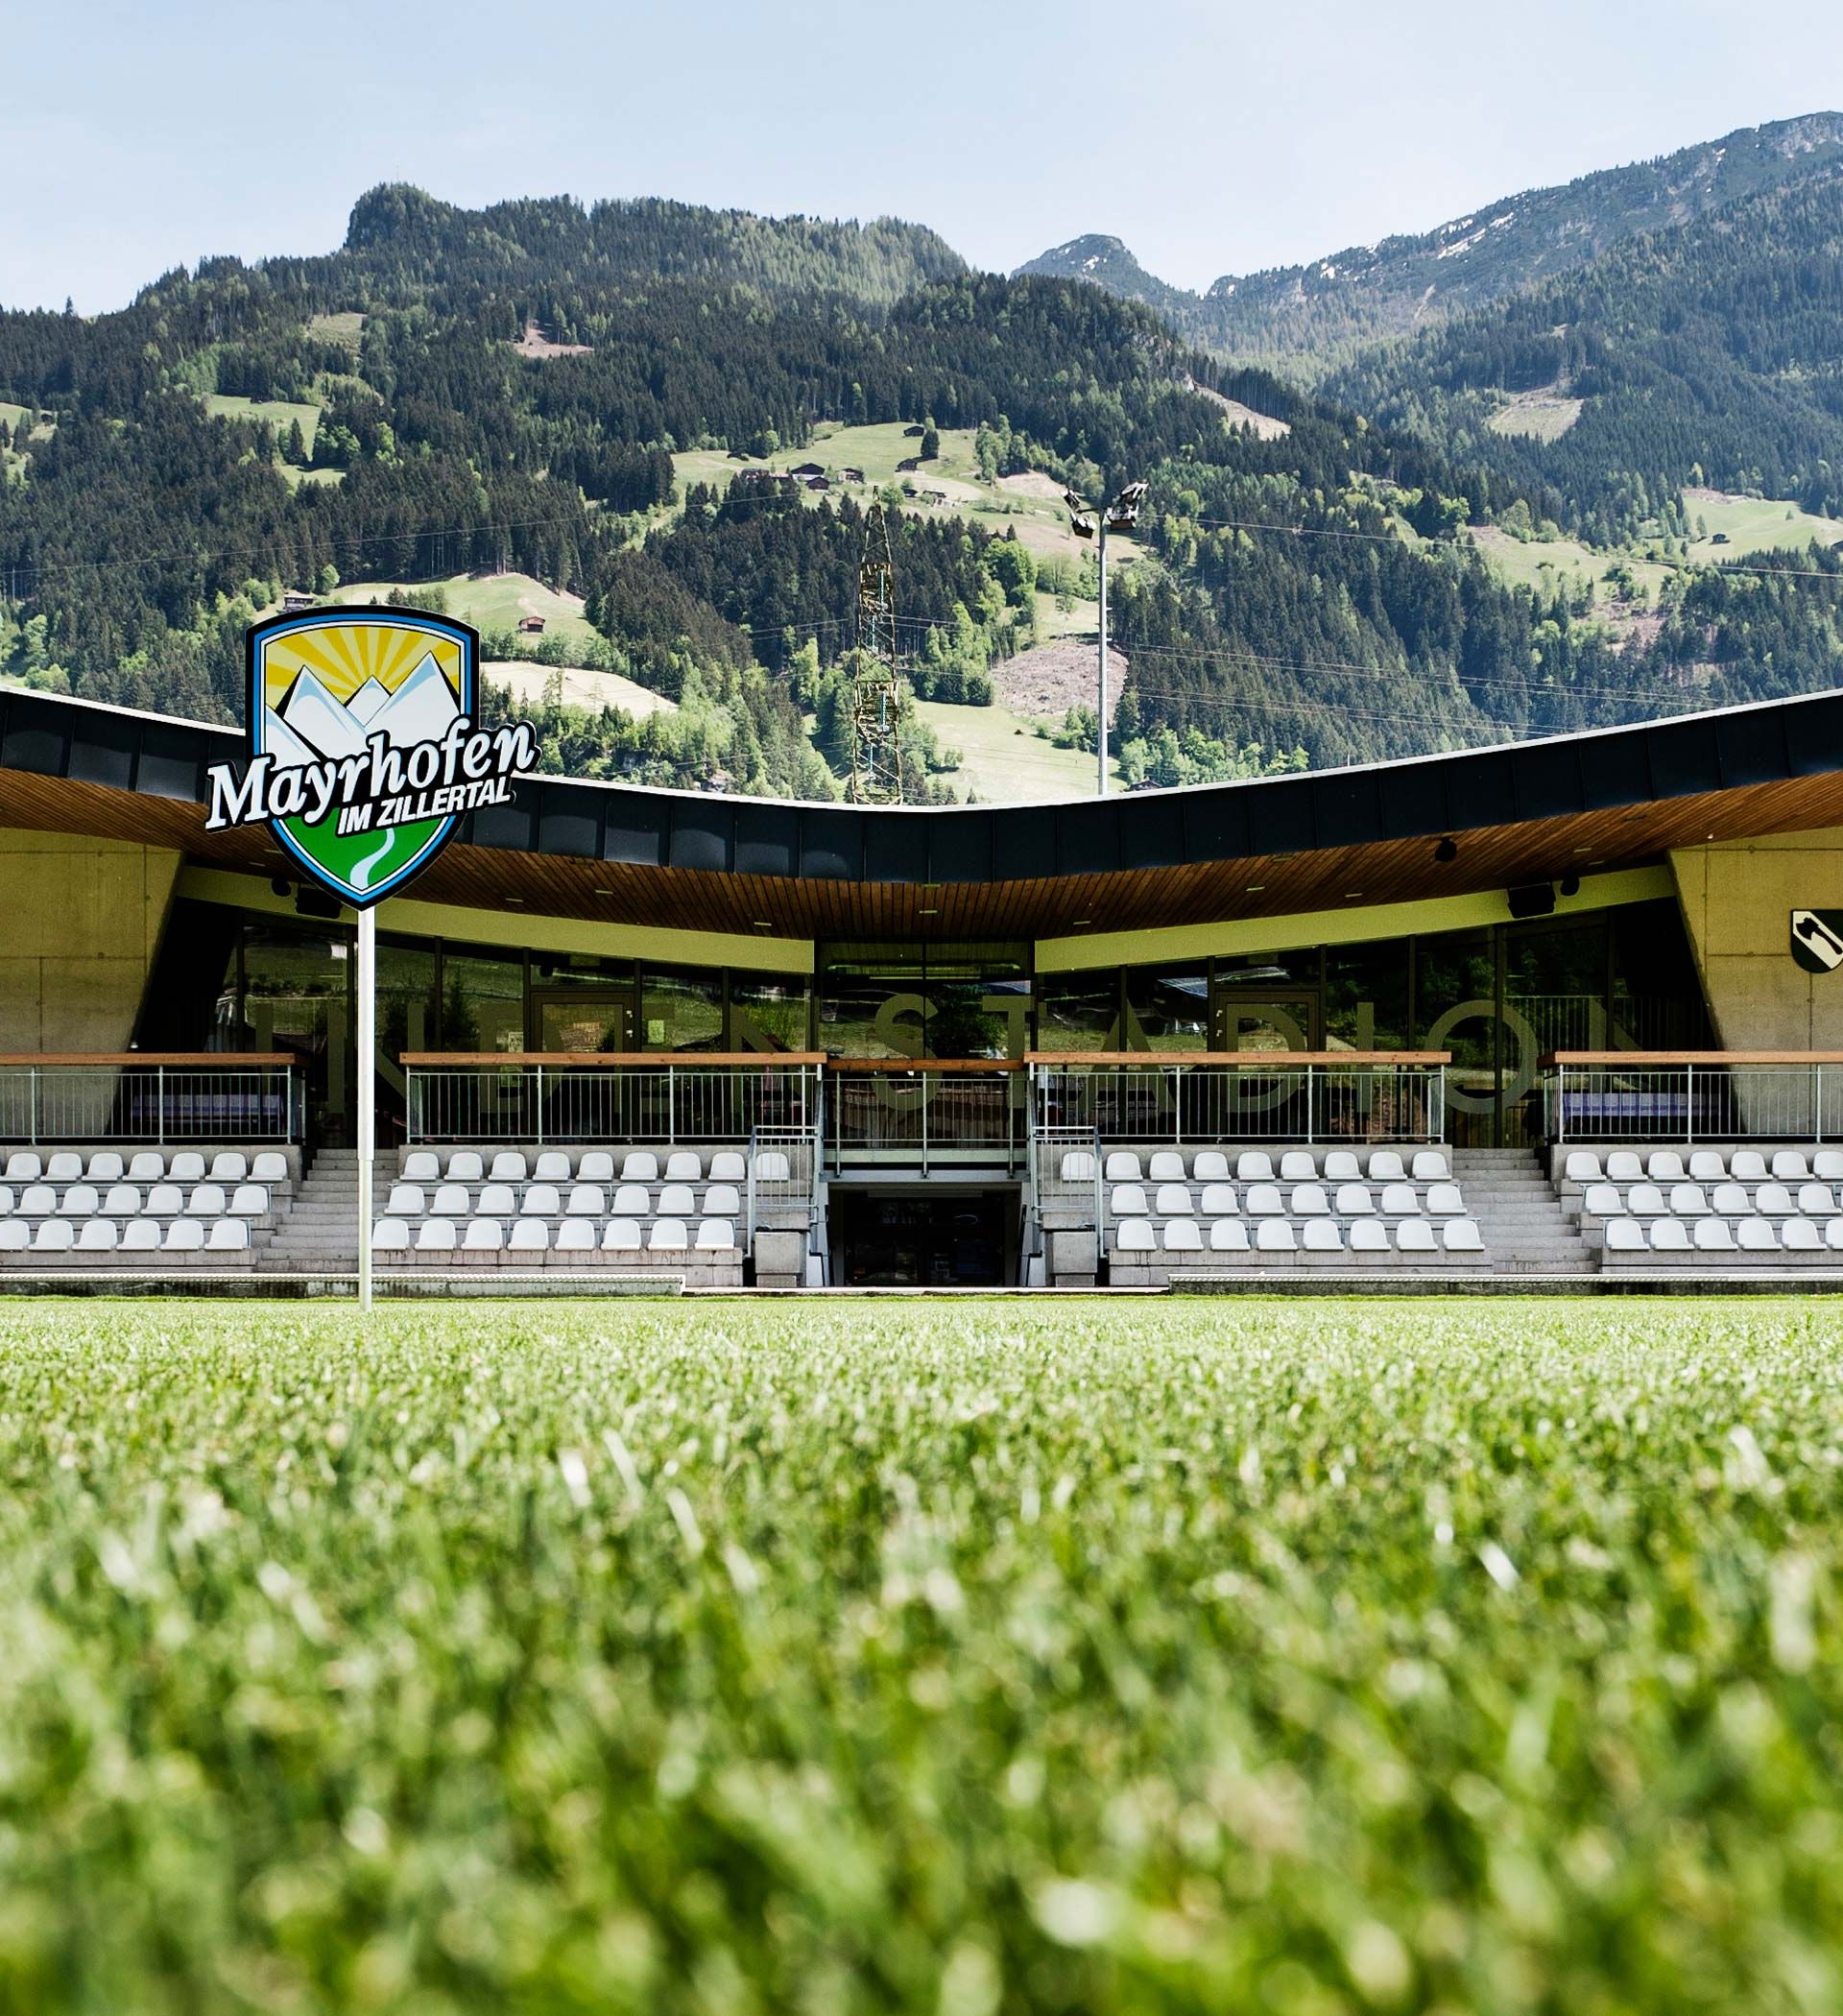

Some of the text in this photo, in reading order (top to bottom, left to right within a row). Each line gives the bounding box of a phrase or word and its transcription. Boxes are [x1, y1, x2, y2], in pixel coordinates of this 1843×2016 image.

[205, 718, 536, 829] Mayrhofen
[338, 778, 512, 834] IM ZILLERTAL
